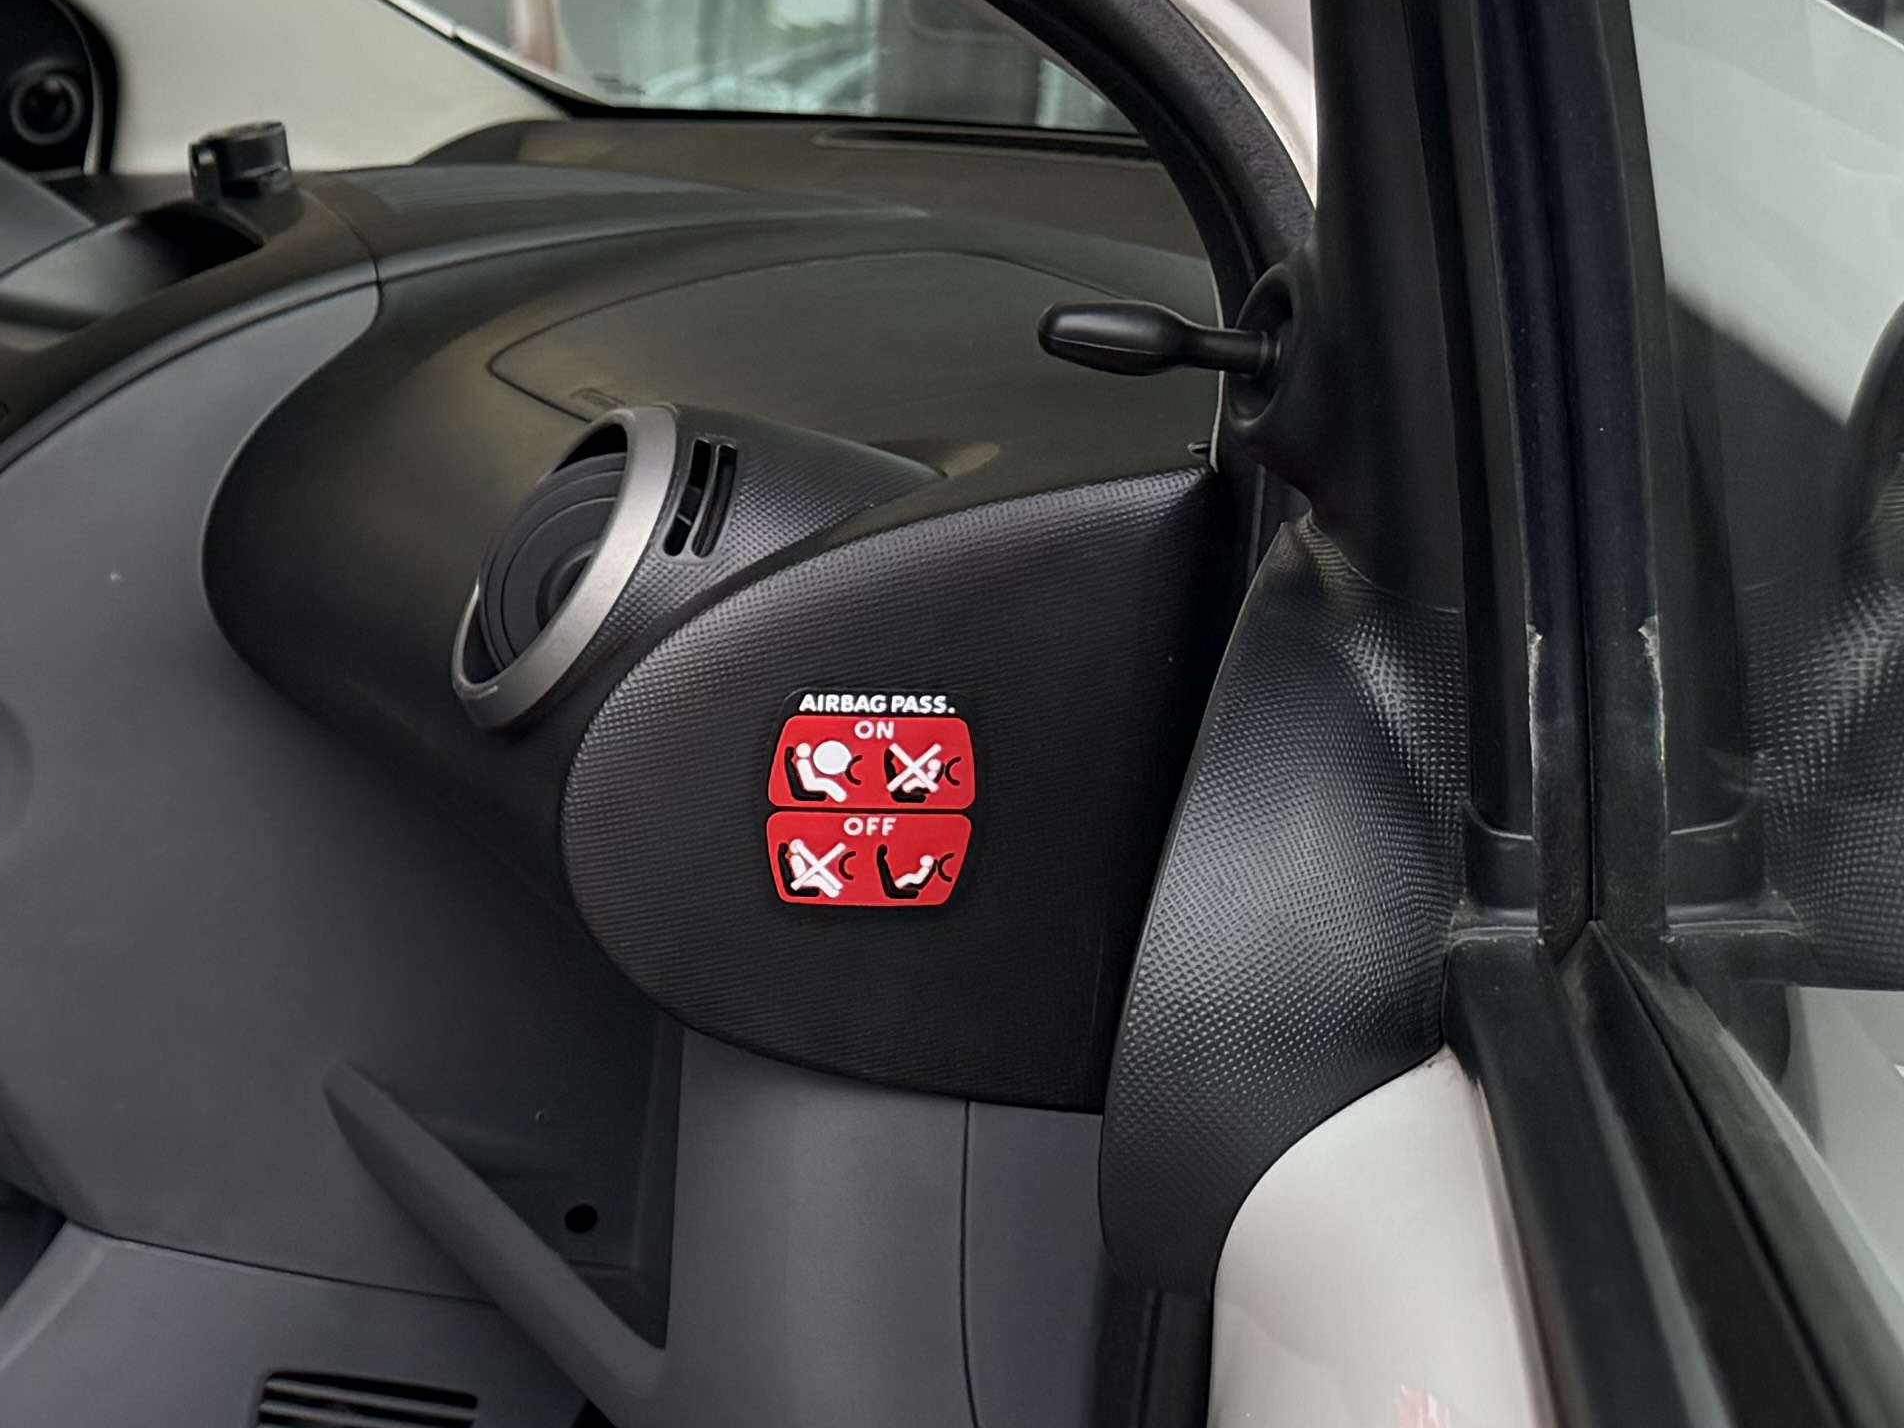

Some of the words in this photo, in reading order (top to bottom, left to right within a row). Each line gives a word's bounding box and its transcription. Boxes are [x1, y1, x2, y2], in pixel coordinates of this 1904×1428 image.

[798, 694, 887, 713] AIRBAG
[891, 695, 956, 714] PASS.
[853, 720, 895, 740] ON
[843, 817, 897, 836] OFF
